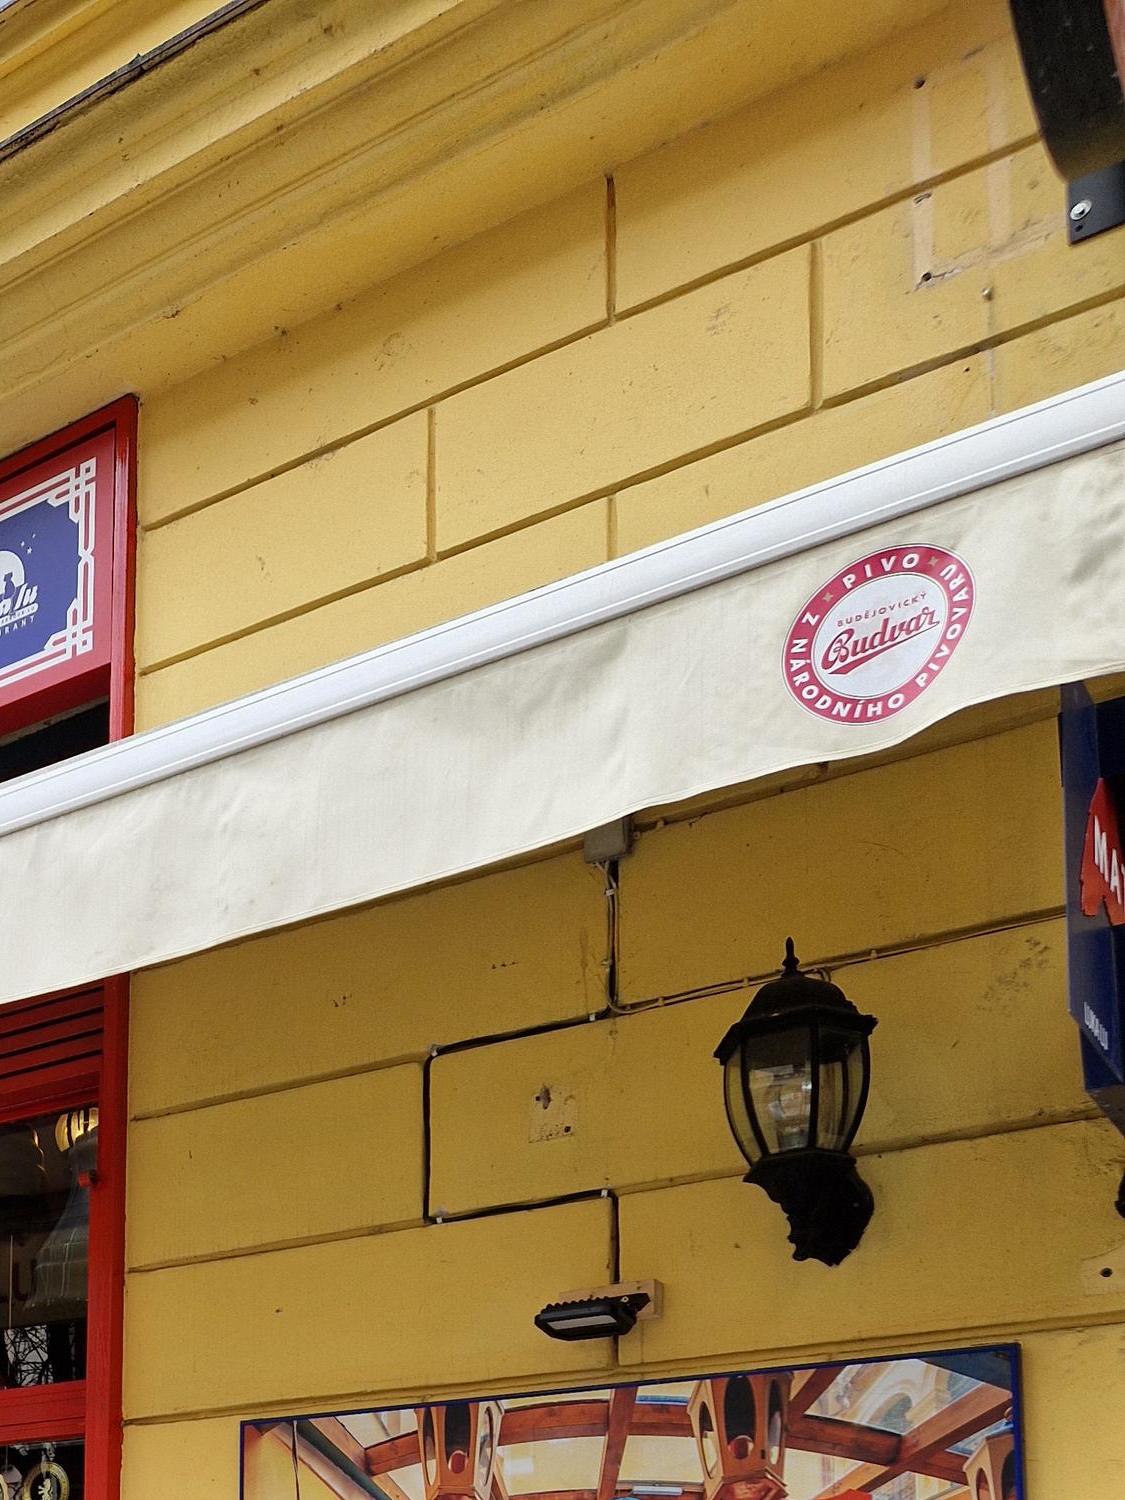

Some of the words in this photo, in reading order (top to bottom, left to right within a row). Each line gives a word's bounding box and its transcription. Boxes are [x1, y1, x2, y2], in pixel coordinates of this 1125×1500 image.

[842, 553, 920, 590] PIVO
[801, 610, 821, 627] Z
[820, 605, 941, 675] Budvar
[836, 591, 928, 628] BUDĚJOVICKÝ
[914, 563, 970, 689] PIVOVARU
[789, 637, 906, 720] NÁRODNÍHO
[1093, 814, 1125, 907] MA
